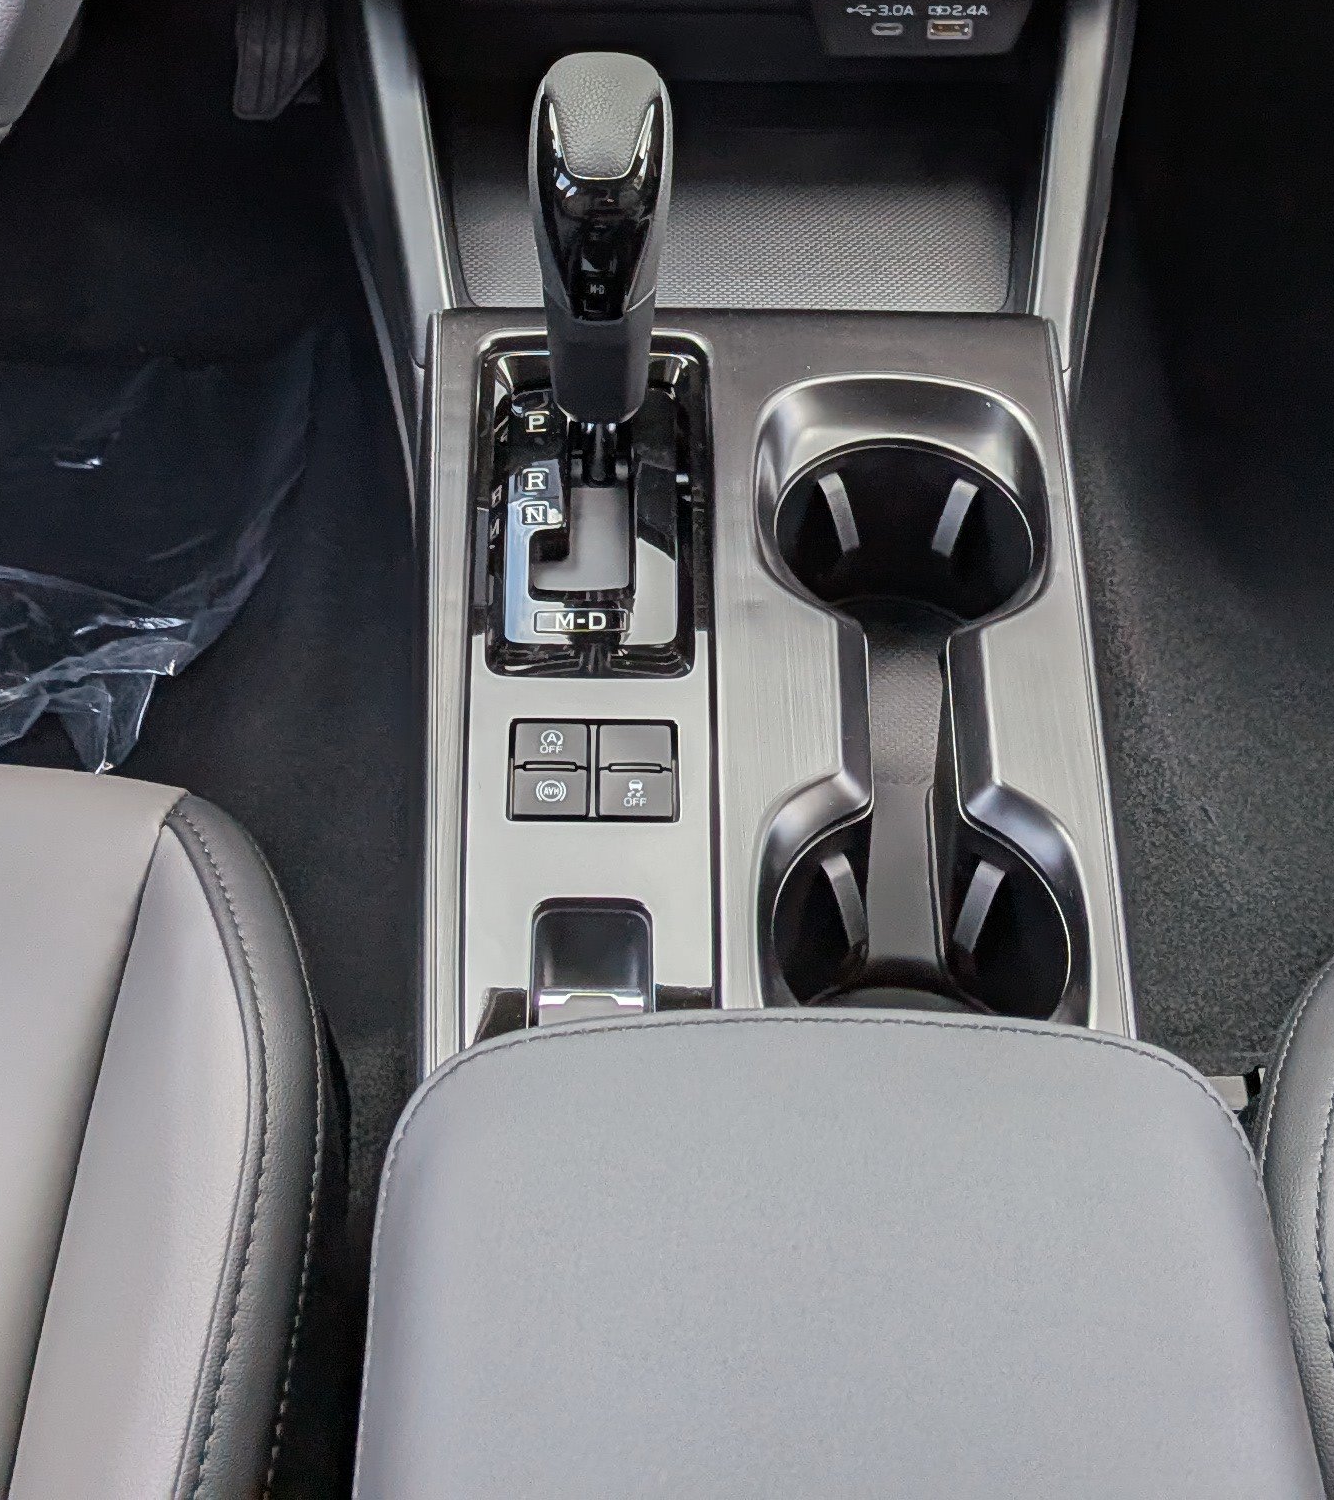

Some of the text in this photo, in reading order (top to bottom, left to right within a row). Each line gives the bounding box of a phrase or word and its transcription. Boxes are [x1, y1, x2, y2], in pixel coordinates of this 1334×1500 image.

[877, 4, 914, 16] 3.0A
[951, 4, 988, 16] 2.4A
[528, 415, 545, 429] P
[525, 473, 547, 491] R
[524, 505, 546, 524] N
[554, 612, 607, 631] M-D
[539, 744, 563, 754] OFF
[543, 786, 560, 796] AVH
[623, 797, 648, 807] OFF
